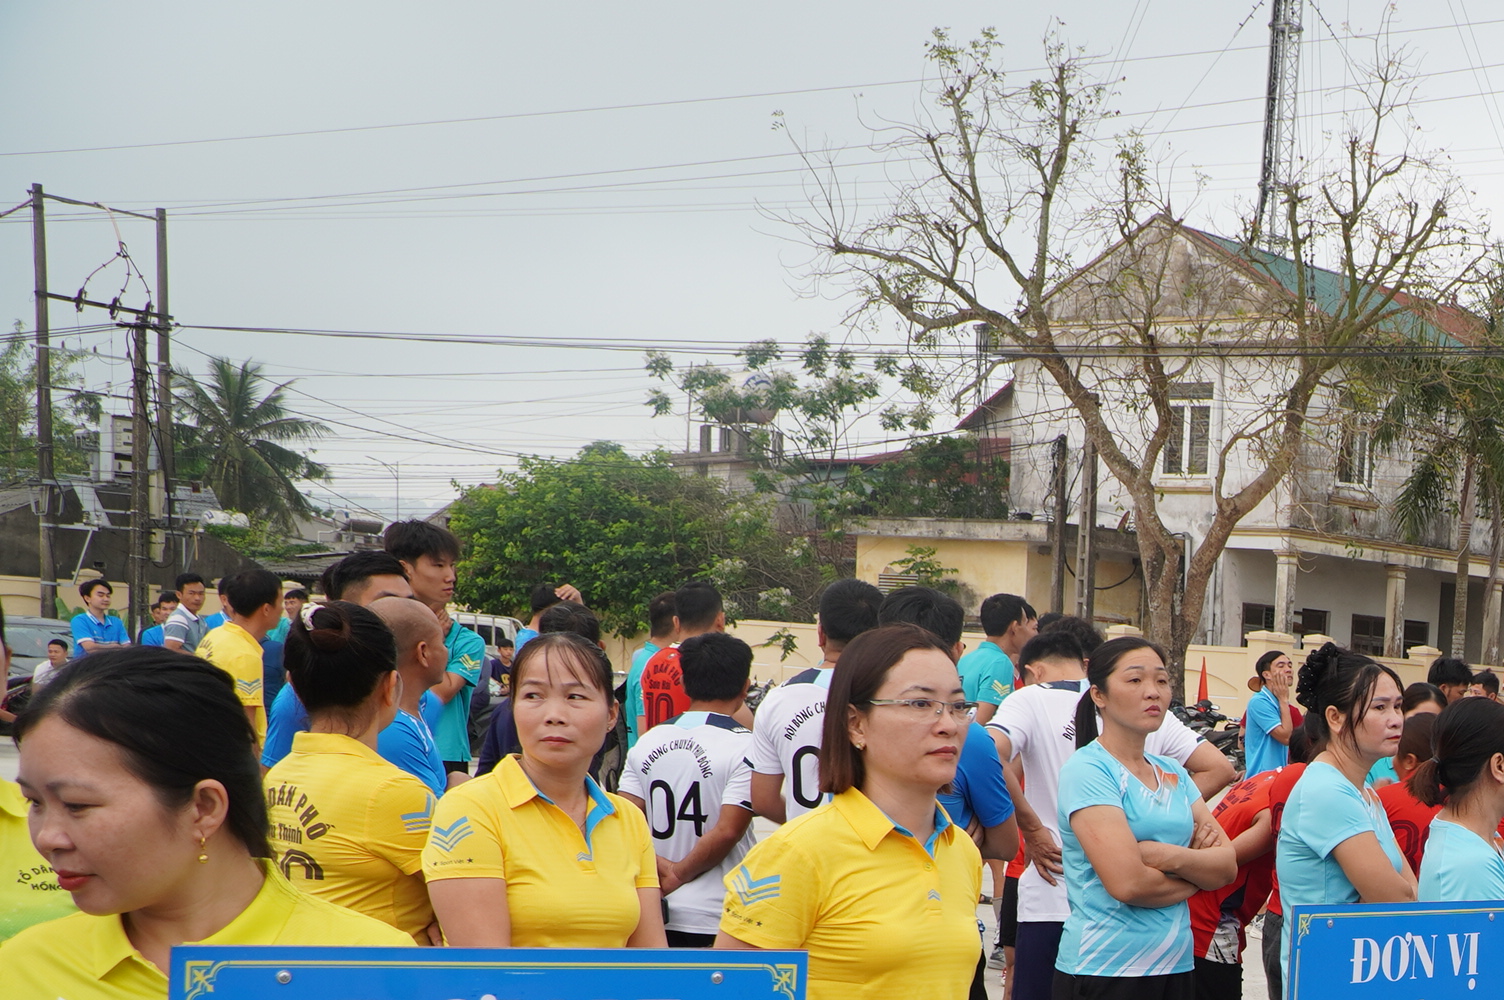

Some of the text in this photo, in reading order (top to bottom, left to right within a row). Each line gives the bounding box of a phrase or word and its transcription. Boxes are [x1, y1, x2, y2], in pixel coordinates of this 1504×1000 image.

[784, 725, 798, 741] ĐỘI
[641, 759, 652, 775] ĐỘI
[294, 793, 336, 841] PHỐ
[650, 779, 708, 840] 04
[1350, 932, 1481, 991] ĐƠN VỊ
